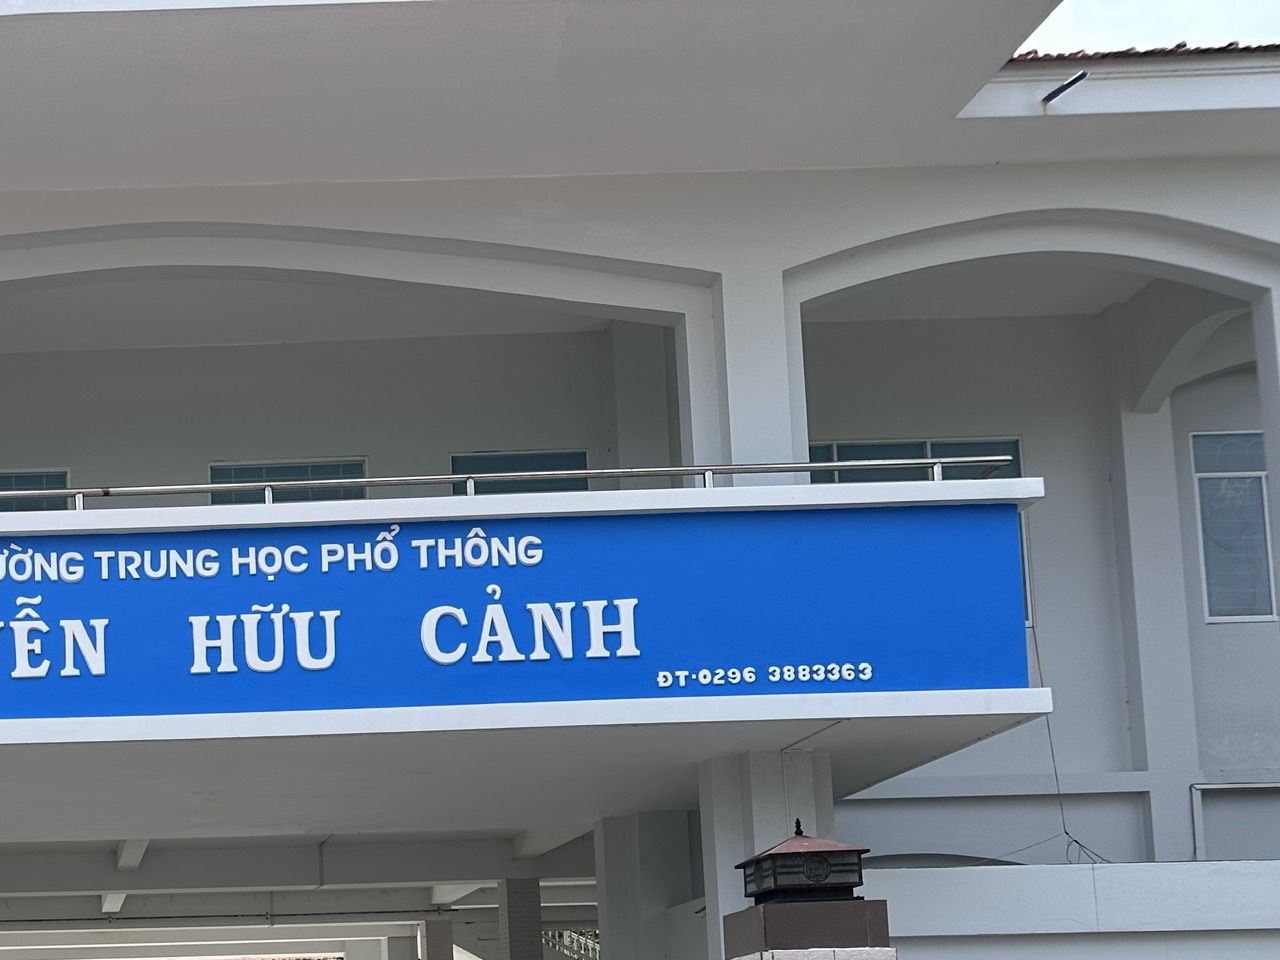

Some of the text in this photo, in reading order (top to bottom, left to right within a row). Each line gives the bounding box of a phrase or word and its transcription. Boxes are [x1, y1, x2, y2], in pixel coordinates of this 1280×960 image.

[94, 548, 220, 581] TRUNG
[231, 544, 308, 583] HỌC
[321, 524, 400, 573] PHỔ
[411, 527, 544, 569] THÔNG
[189, 603, 342, 676] HỮU
[419, 584, 641, 663] CẢNH
[768, 663, 873, 683] 3883363
